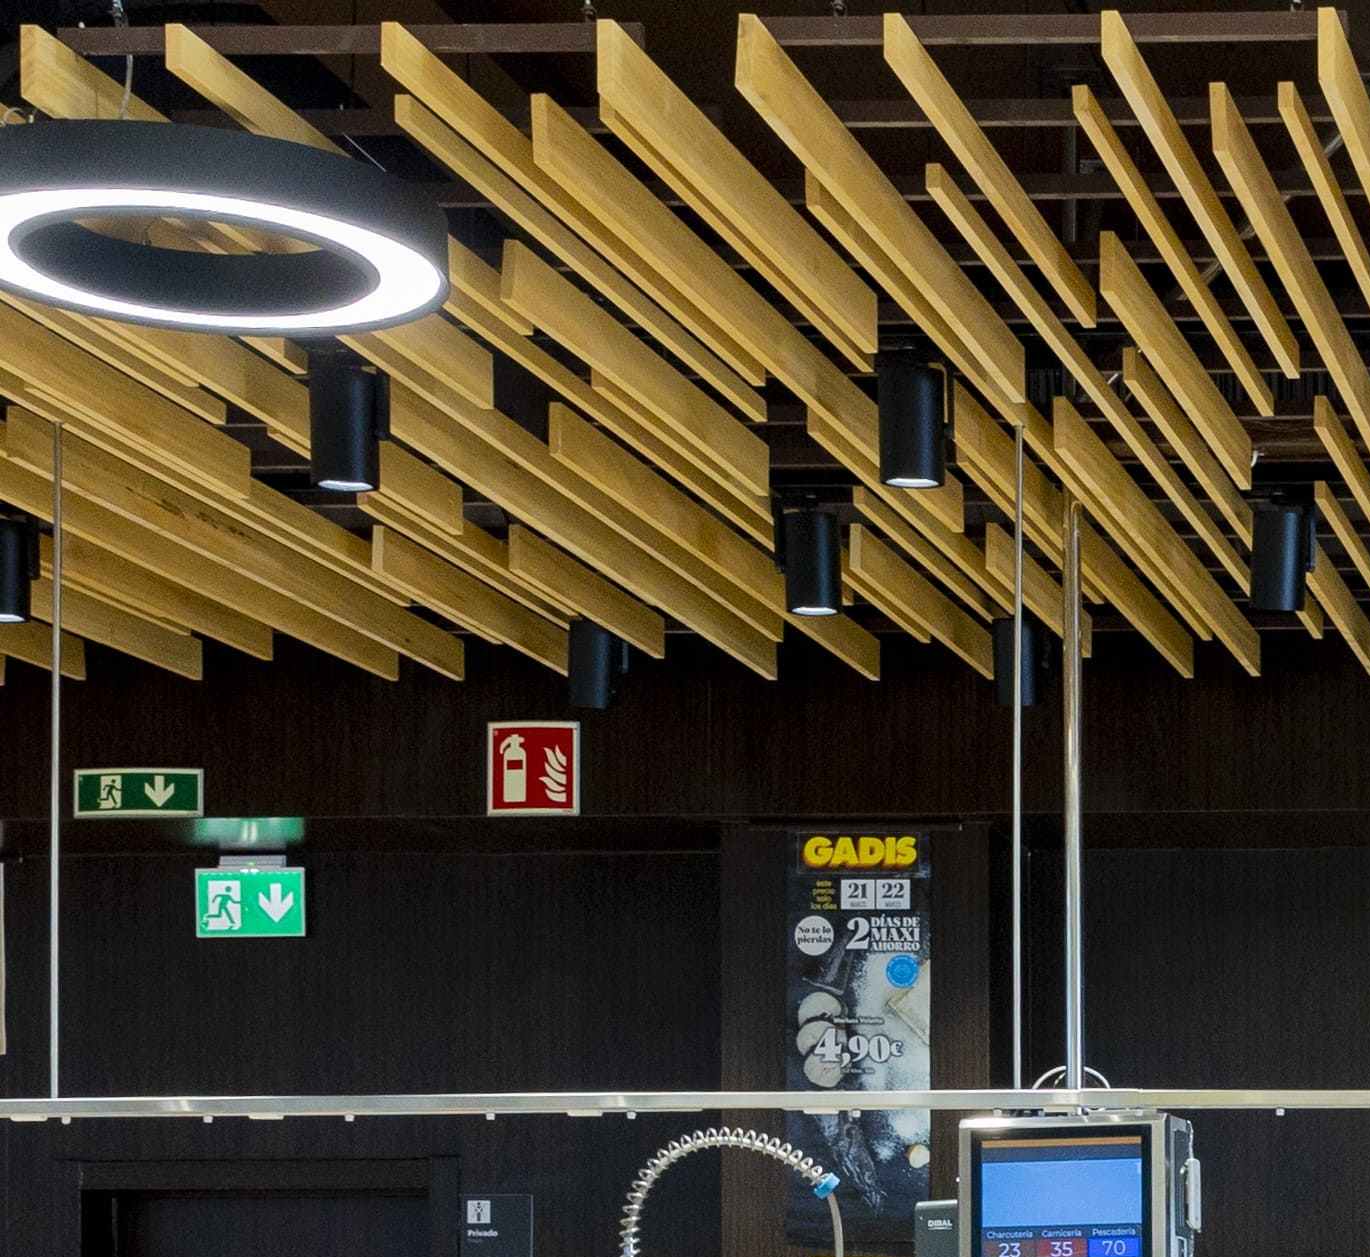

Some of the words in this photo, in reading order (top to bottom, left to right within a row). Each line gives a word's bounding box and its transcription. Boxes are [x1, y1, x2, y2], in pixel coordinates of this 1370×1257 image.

[803, 836, 918, 868] GADIS
[848, 883, 868, 899] 21
[882, 883, 905, 899] 22
[871, 914, 901, 927] DÍAS
[903, 916, 920, 927] DE
[846, 917, 870, 949] 2
[871, 928, 920, 941] MAXI
[870, 942, 920, 952] AHORRO
[814, 1027, 903, 1068] 4,90€
[1050, 1241, 1073, 1257] 35
[1102, 1240, 1126, 1256] 70
